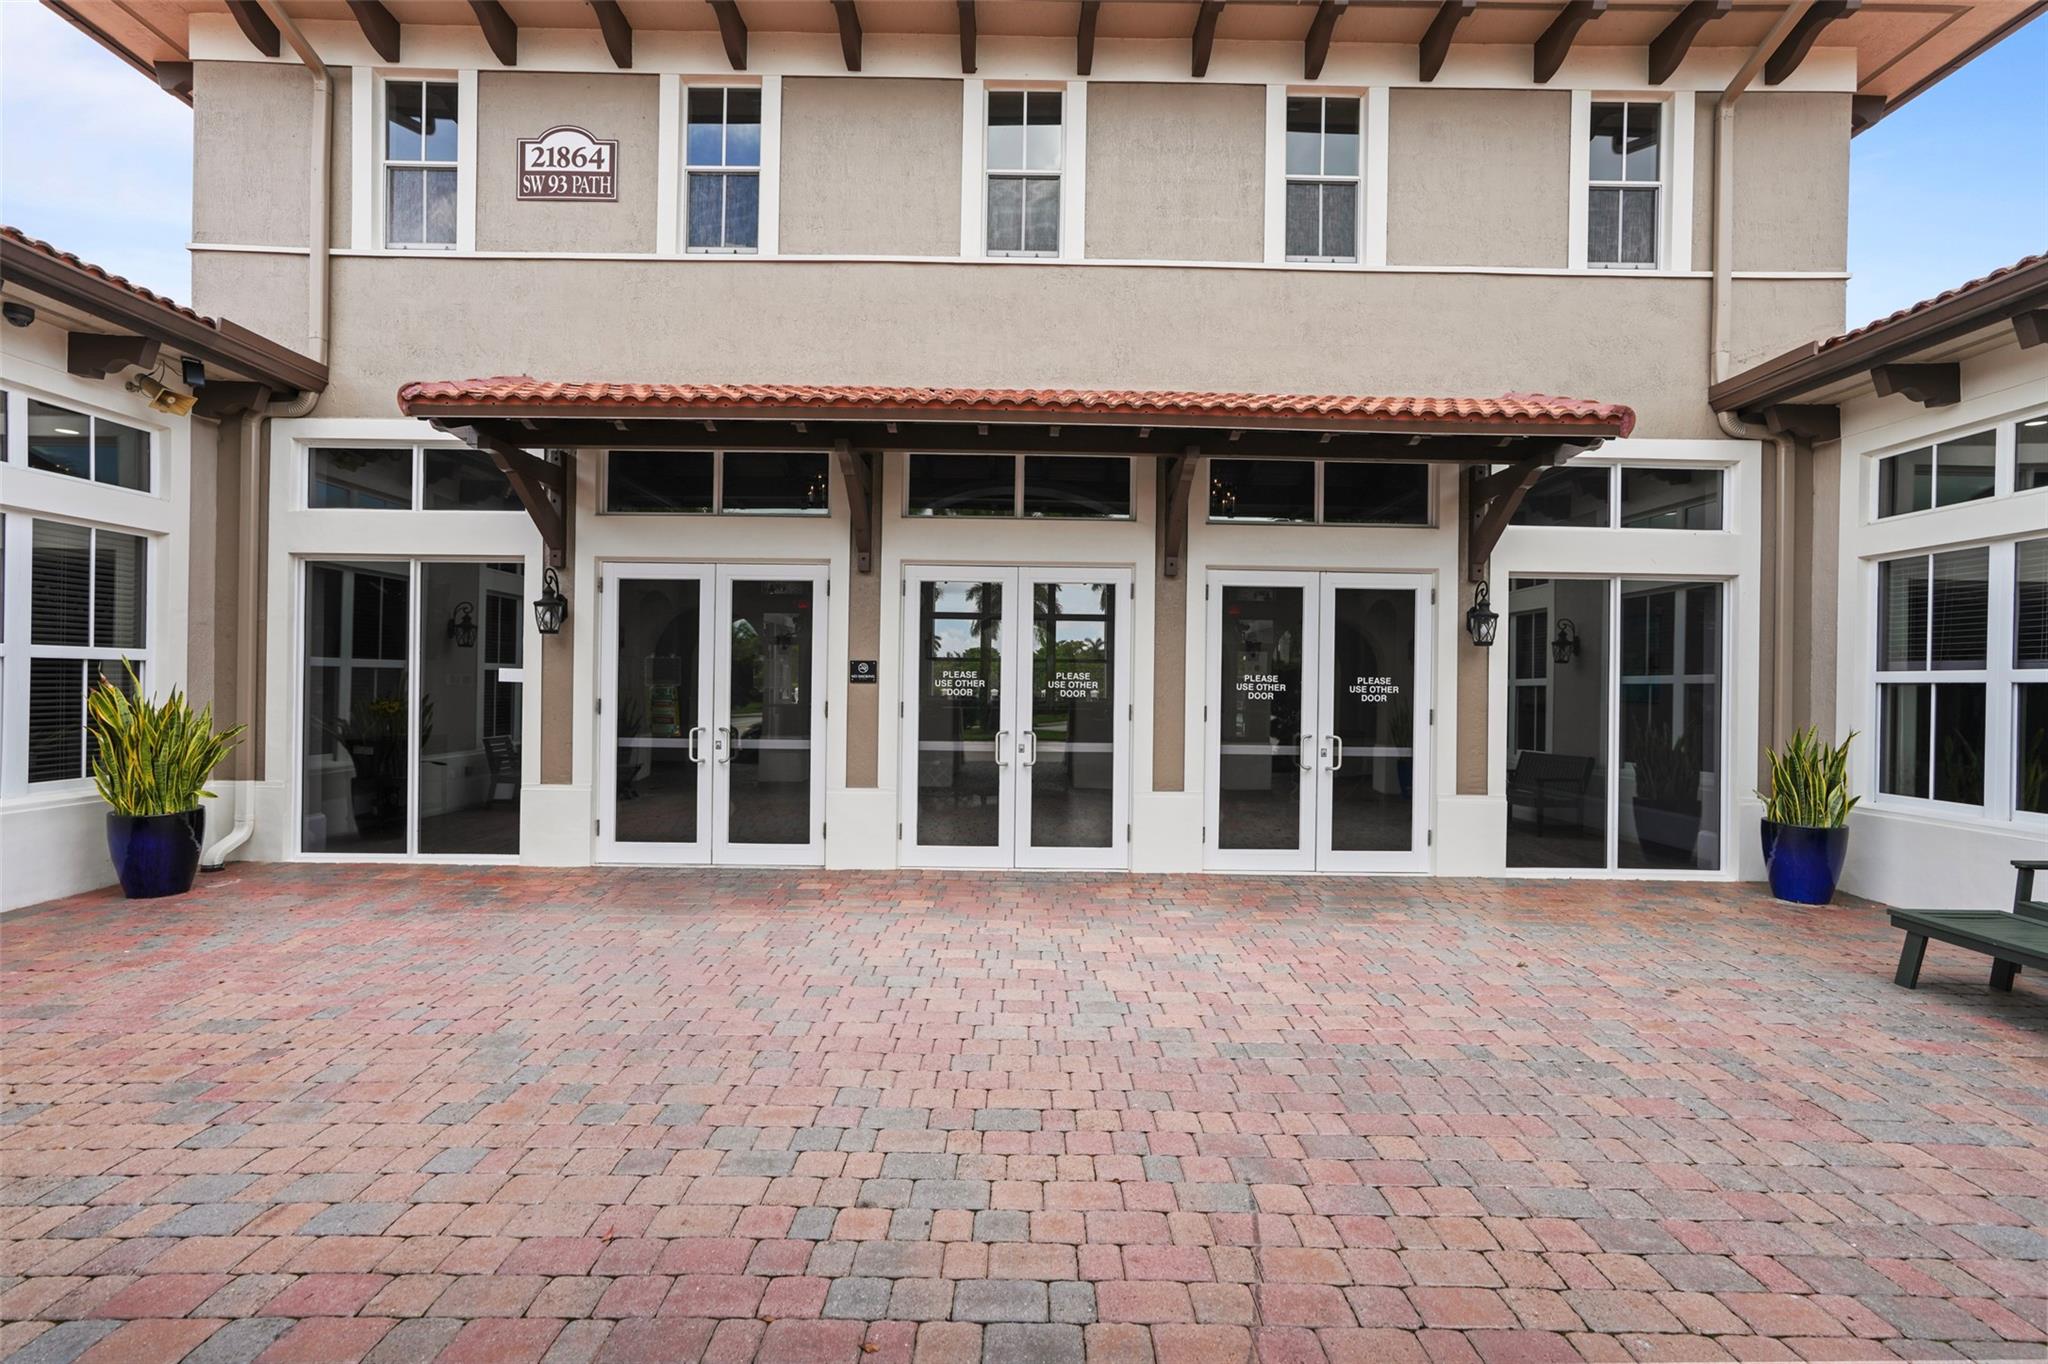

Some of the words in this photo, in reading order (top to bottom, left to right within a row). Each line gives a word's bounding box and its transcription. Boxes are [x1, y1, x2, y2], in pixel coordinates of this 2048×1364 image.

[531, 146, 605, 170] 21864
[523, 175, 545, 193] SW
[548, 175, 568, 193] 93
[572, 176, 612, 195] PATH
[942, 670, 978, 679] PLEASE
[1056, 672, 1091, 680] PLEASE
[1244, 674, 1279, 683] PLEASE
[934, 679, 953, 687] USE
[955, 679, 986, 688] OTHER
[1047, 681, 1066, 689] USE
[1068, 681, 1098, 689] OTHER
[1357, 676, 1392, 685] PLEASE
[1236, 683, 1254, 691] USE
[1256, 683, 1286, 692] OTHER
[1349, 685, 1367, 694] USE
[1369, 685, 1399, 694] OTHER
[946, 688, 973, 697] DOOR
[1060, 689, 1086, 698] DOOR
[1248, 691, 1274, 700] DOOR
[1361, 694, 1387, 702] DOOR
